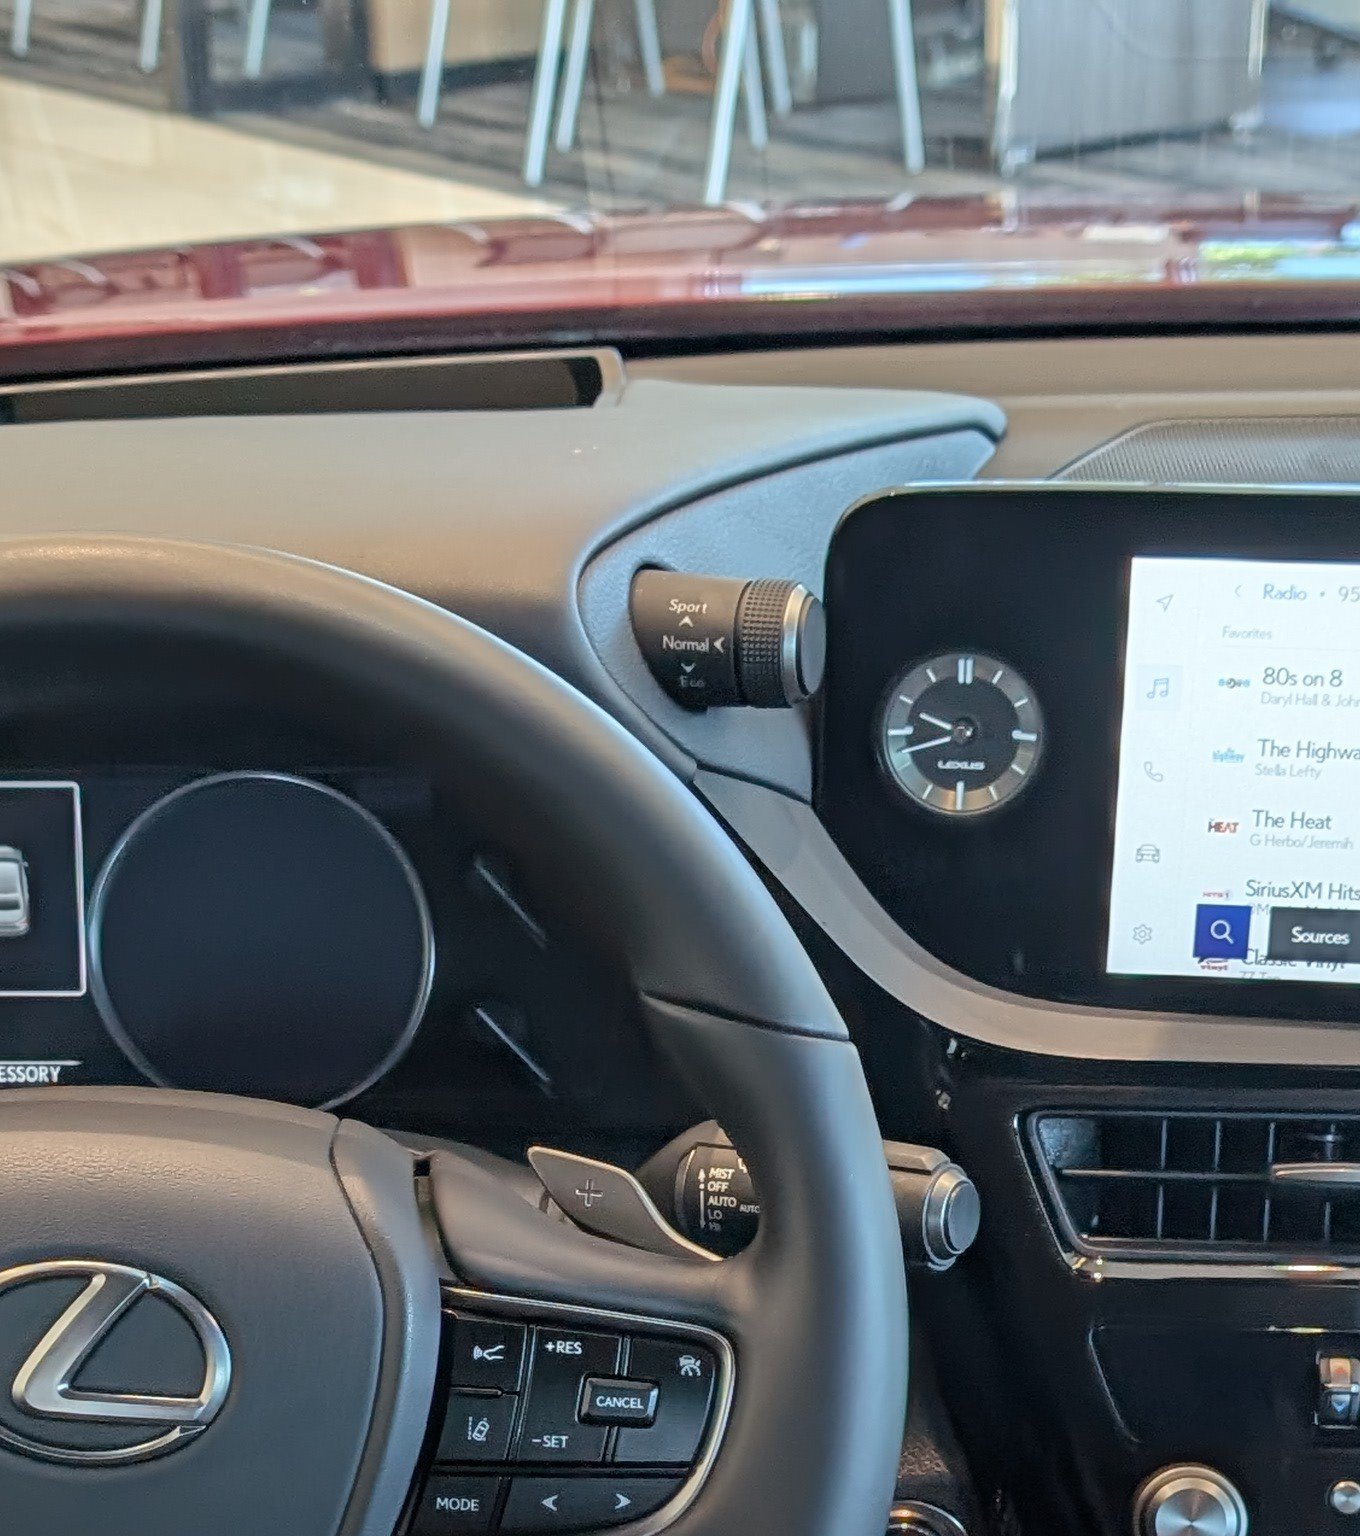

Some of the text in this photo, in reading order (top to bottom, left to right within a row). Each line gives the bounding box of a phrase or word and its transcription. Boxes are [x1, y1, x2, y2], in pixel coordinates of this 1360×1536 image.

[1263, 583, 1307, 601] Radio
[668, 598, 708, 615] Sport
[1221, 625, 1273, 640] Favorites
[662, 635, 710, 653] Normal
[1262, 667, 1298, 686] 80s
[1302, 673, 1325, 687] on
[1329, 669, 1343, 687] 8
[1295, 692, 1318, 706] Hall
[1321, 693, 1331, 707] &
[1257, 738, 1291, 758] The
[937, 760, 986, 771] LEXUS
[1289, 764, 1323, 780] Lefty
[1252, 809, 1333, 830] The Heat
[1245, 879, 1323, 900] SiriusXM
[1290, 926, 1351, 946] Sources
[708, 1167, 736, 1180] MIST
[707, 1180, 730, 1193] OFF
[707, 1195, 738, 1208] AUTO
[707, 1208, 723, 1220] LO
[595, 1395, 645, 1410] CANCEL
[435, 1497, 480, 1512] MODE
